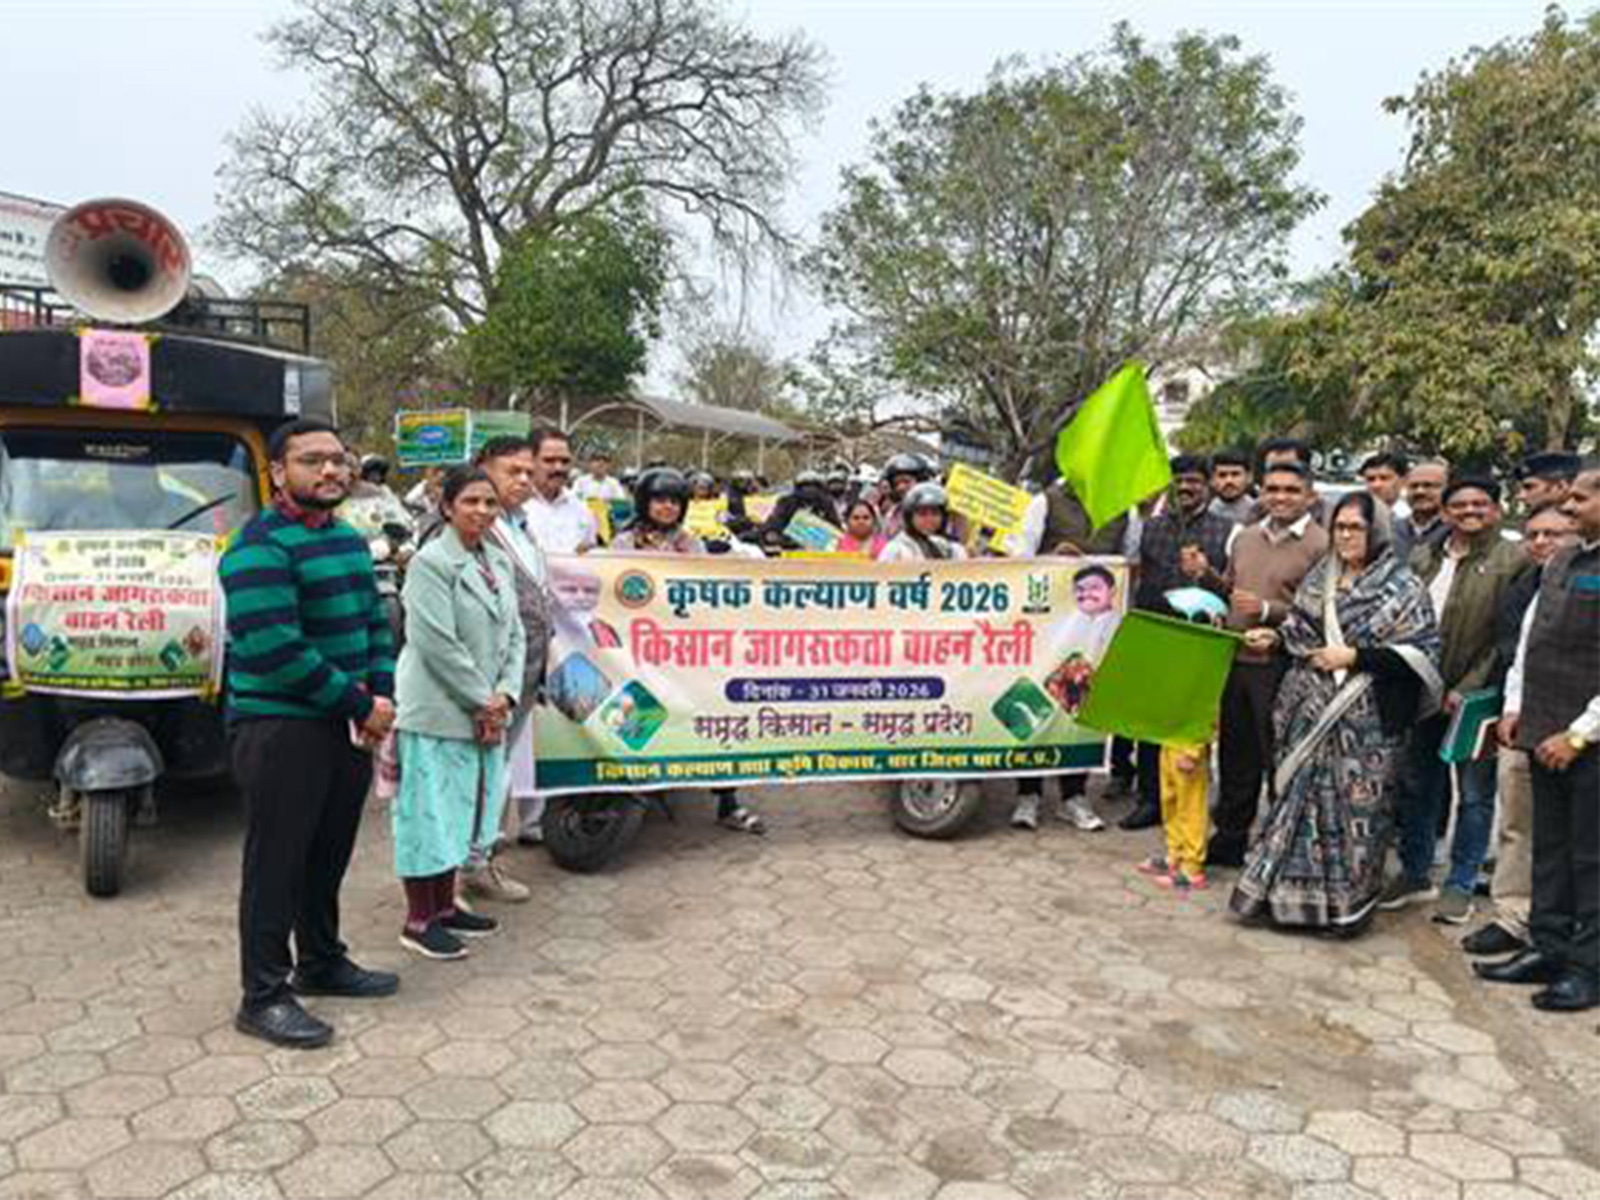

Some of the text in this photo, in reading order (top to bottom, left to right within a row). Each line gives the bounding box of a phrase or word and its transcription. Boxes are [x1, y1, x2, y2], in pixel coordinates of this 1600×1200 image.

[665, 572, 1010, 618] कृषक कल्याण वर्ष 2026
[630, 617, 735, 667] किसान
[901, 629, 976, 667] वाहन
[974, 618, 1035, 667] रैली
[742, 680, 792, 700] दिनांक
[808, 684, 830, 699] 31
[831, 679, 882, 699] जनवरी
[886, 683, 931, 699] 2026
[694, 714, 750, 750] समृद्ध
[757, 705, 833, 739] किसान
[862, 711, 915, 744] समृद्ध
[923, 702, 973, 736] प्रदेश
